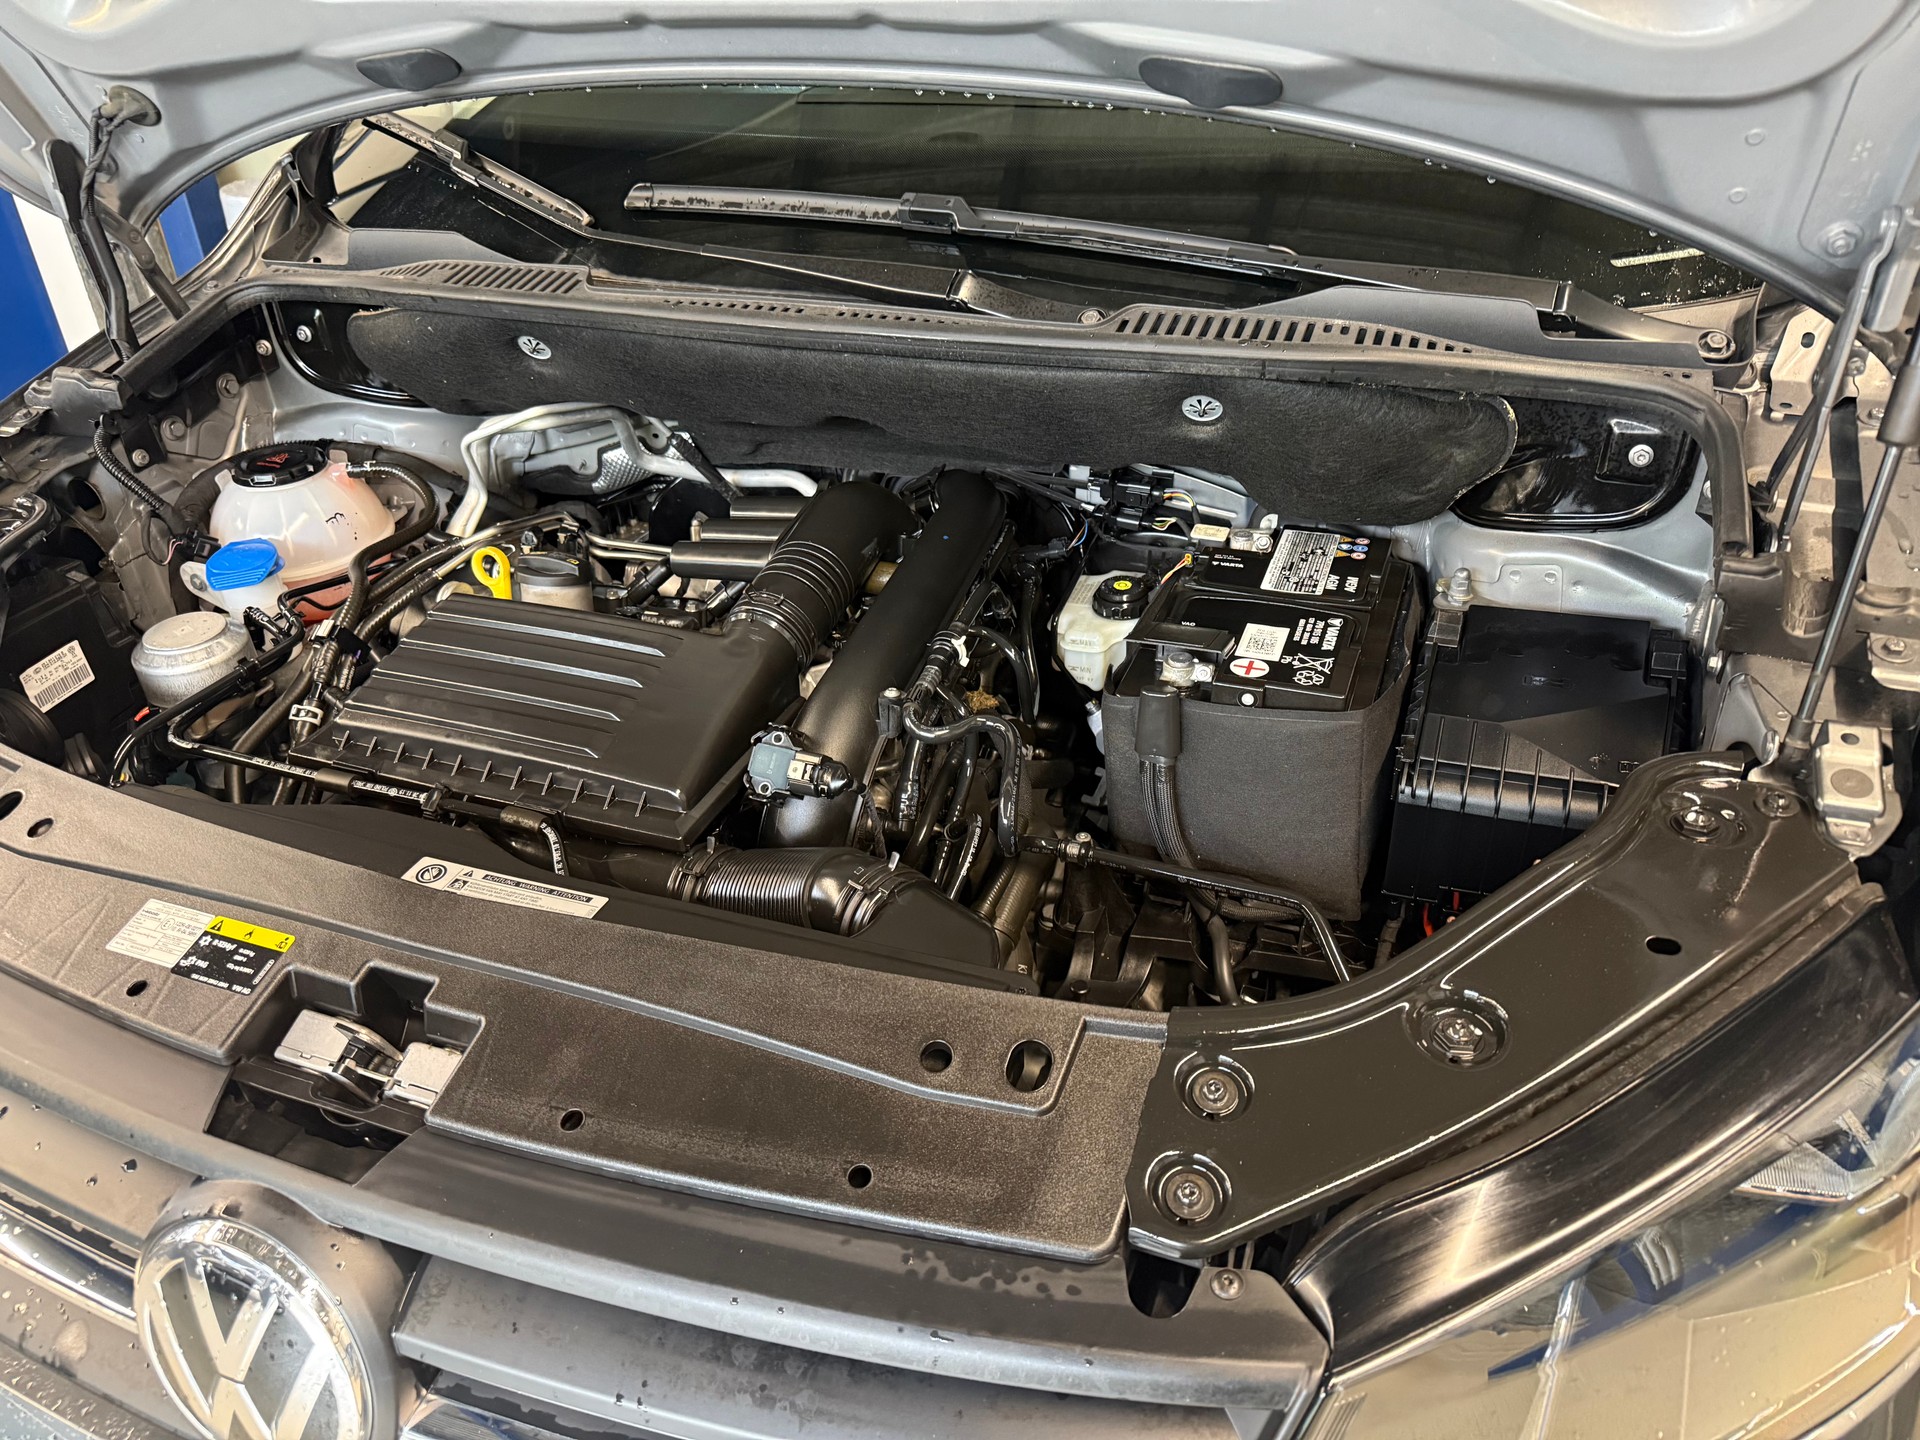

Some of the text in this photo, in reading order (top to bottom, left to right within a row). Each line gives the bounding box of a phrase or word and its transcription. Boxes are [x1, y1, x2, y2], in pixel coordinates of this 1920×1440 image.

[1325, 574, 1340, 590] AGM
[1321, 627, 1340, 651] VARTA
[1280, 655, 1293, 664] Pb
[485, 875, 517, 887] ACHTUNG
[519, 882, 550, 894] WARNING
[552, 889, 589, 902] ATTENTION
